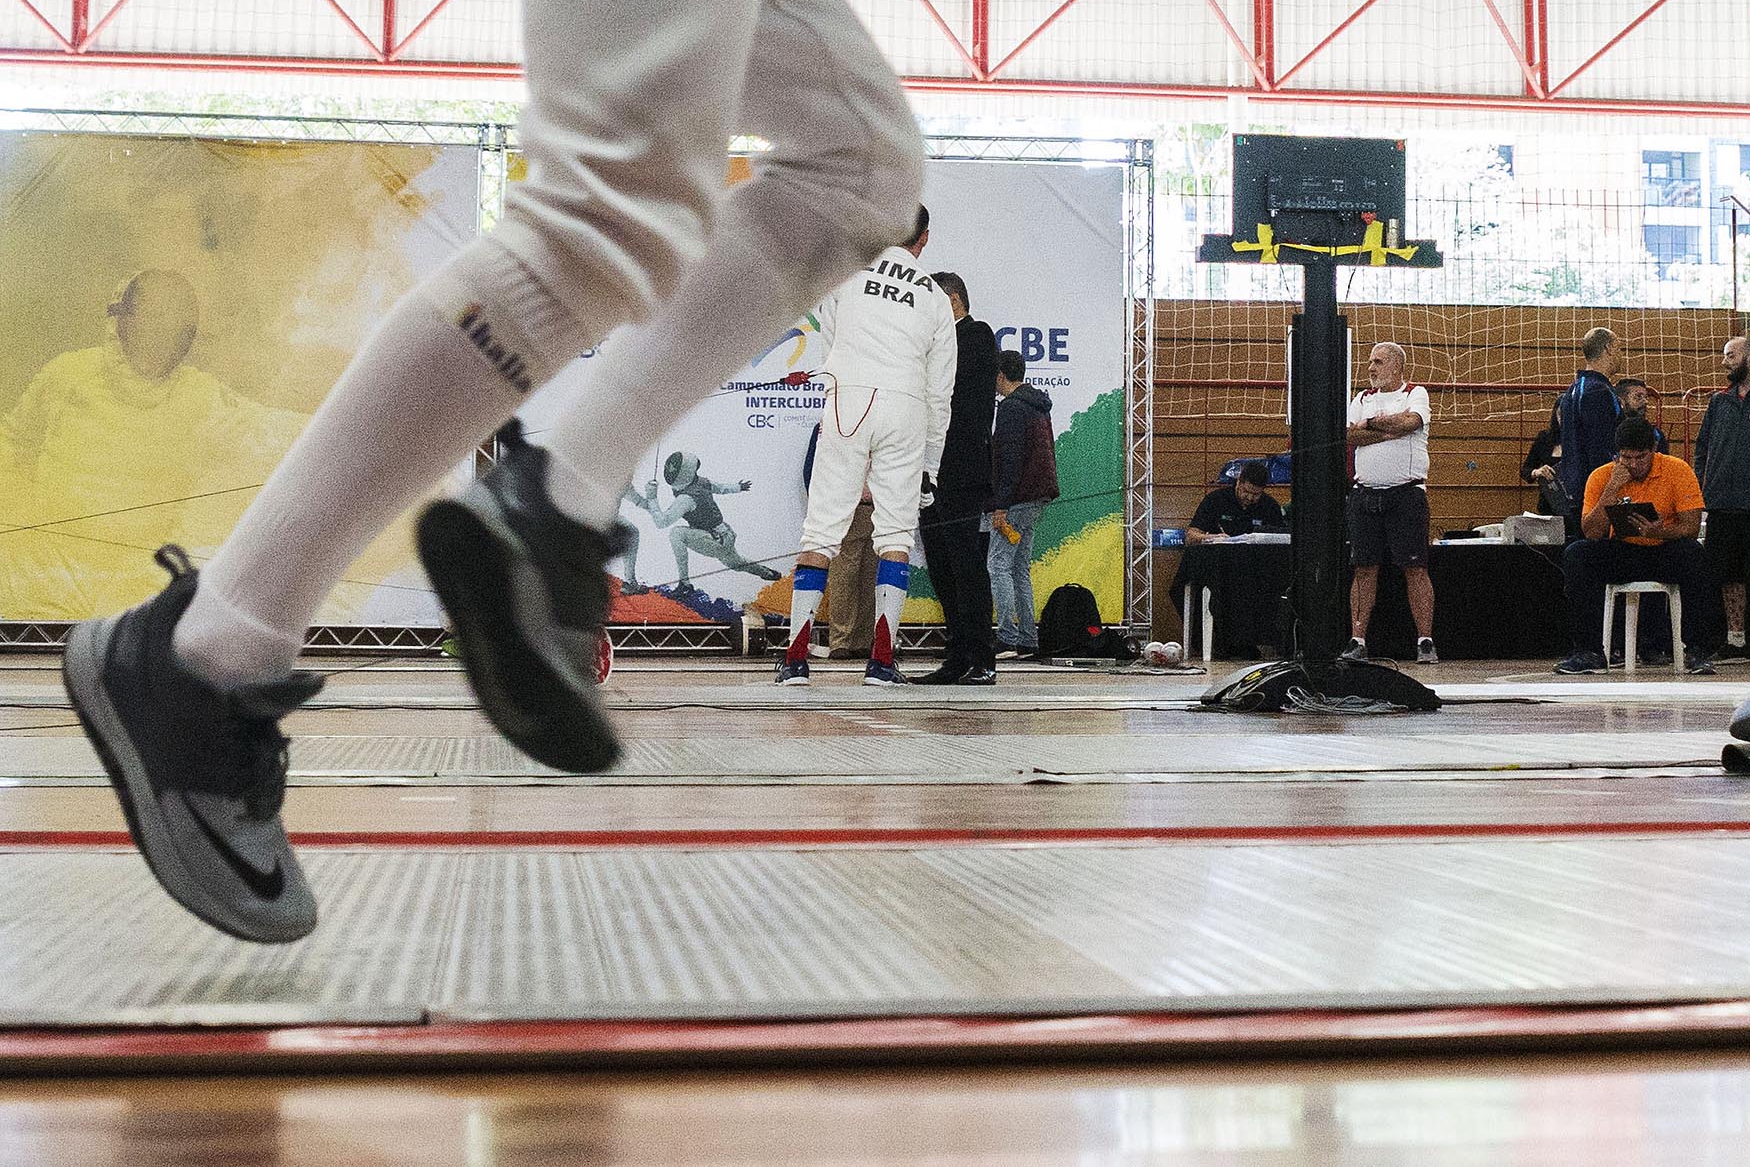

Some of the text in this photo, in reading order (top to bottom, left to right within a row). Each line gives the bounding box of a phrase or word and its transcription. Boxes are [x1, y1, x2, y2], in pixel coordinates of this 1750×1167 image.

[864, 260, 933, 293] IMA
[863, 280, 915, 308] BRA
[803, 381, 825, 392] Bra
[1025, 376, 1071, 389] DERAÇÃO
[747, 414, 775, 429] CBC
